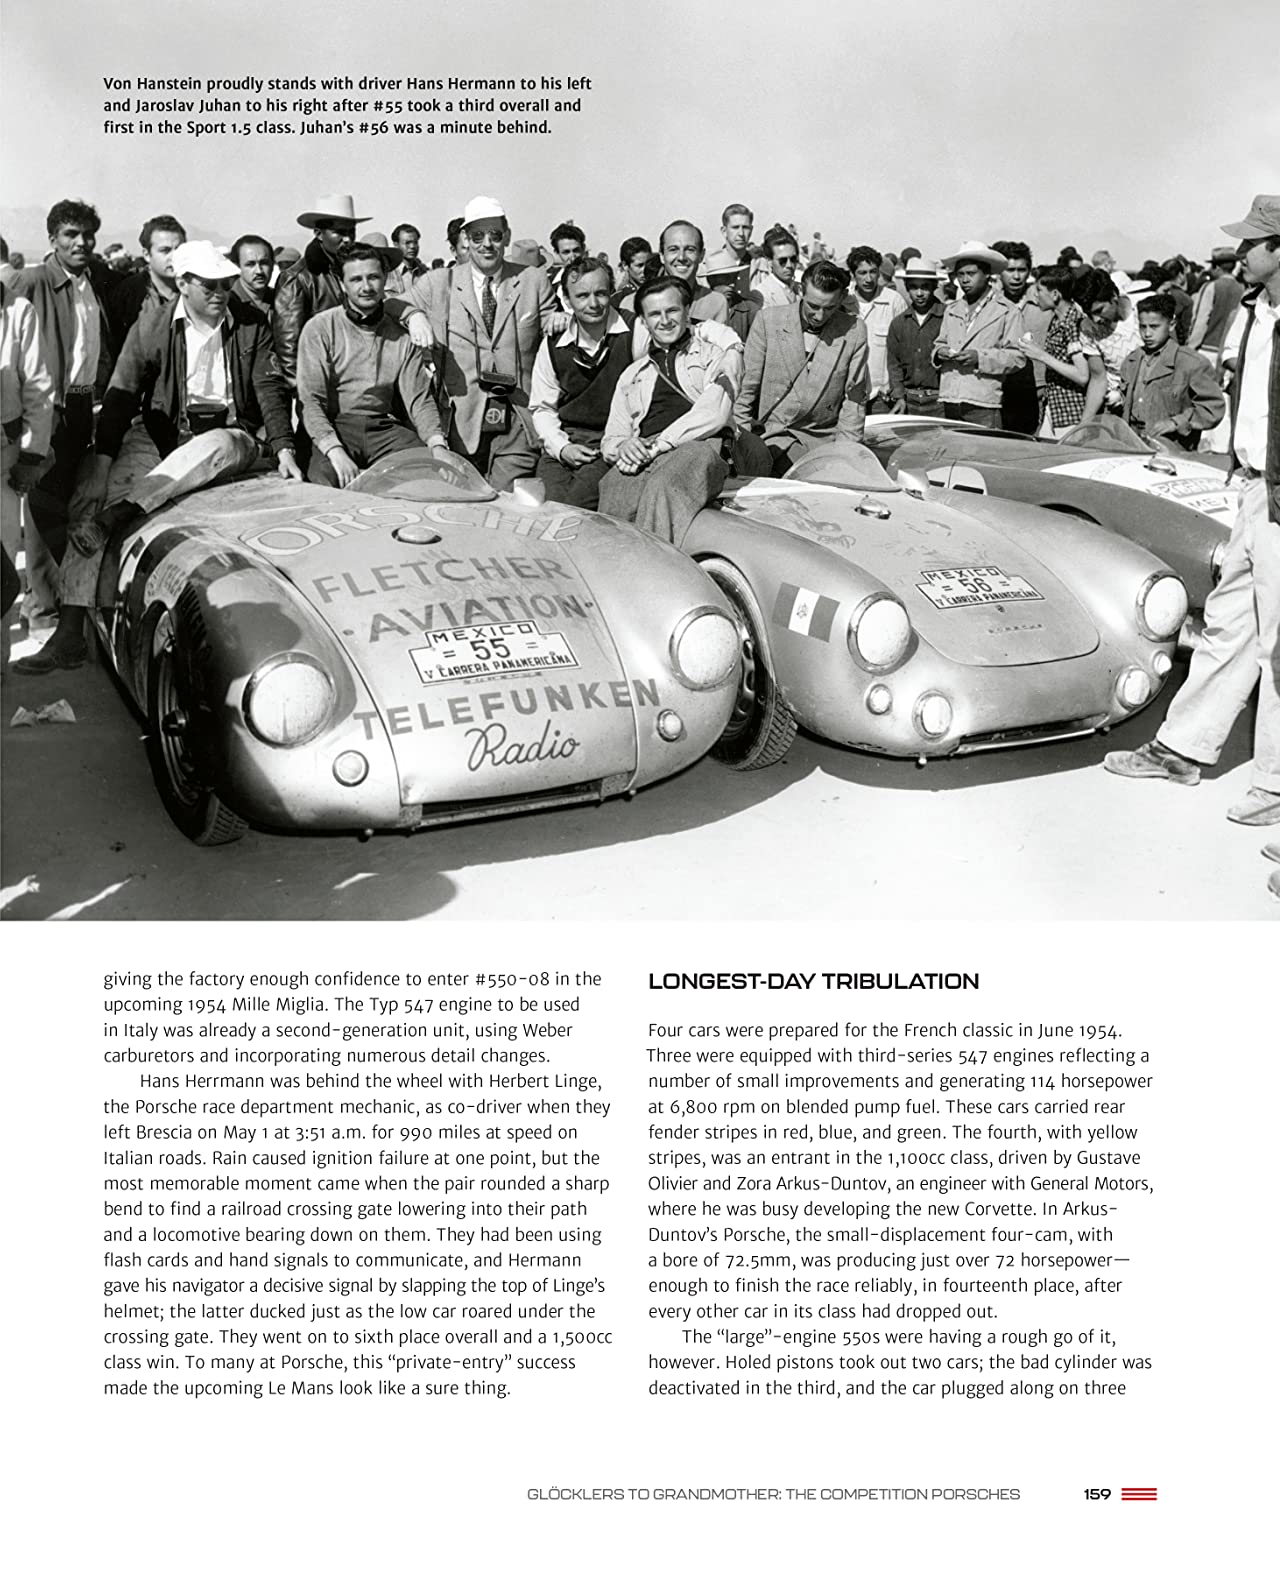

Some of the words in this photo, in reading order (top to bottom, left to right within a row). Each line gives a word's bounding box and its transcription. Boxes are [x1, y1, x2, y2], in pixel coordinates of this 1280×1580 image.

[102, 77, 132, 91] Von
[137, 76, 202, 91] Hanstein
[206, 75, 264, 94] proudly
[267, 75, 317, 91] stands
[320, 75, 354, 91] with
[358, 75, 403, 91] driver
[406, 77, 444, 91] Hans
[448, 77, 516, 91] Hermann
[519, 78, 537, 91] to
[540, 75, 563, 91] his
[567, 76, 593, 91] left
[103, 97, 131, 112] and
[134, 98, 195, 114] Jaroslav
[198, 97, 241, 114] Juhan
[245, 99, 262, 112] to
[266, 97, 288, 112] his
[292, 97, 328, 116] right
[332, 98, 369, 112] after
[373, 100, 403, 114] #55
[406, 98, 442, 113] took
[444, 101, 454, 113] a
[457, 97, 495, 113] third
[499, 98, 550, 113] overall
[554, 97, 582, 113] and
[103, 119, 135, 134] first
[138, 120, 153, 134] in
[157, 119, 183, 134] the
[186, 120, 227, 138] Sport
[230, 122, 252, 136] 1.5
[255, 120, 296, 134] class.
[299, 119, 355, 136] Juhan’s
[358, 120, 389, 136] #56
[393, 123, 423, 134] was
[426, 123, 435, 134] a
[440, 120, 493, 134] minute
[497, 119, 552, 134] behind.
[312, 556, 574, 603] FLETCHER
[927, 567, 1000, 581] MEXICO
[958, 577, 993, 594] 56
[431, 622, 534, 644] MEXICO
[470, 637, 511, 661] 55
[439, 661, 490, 678] CARRERA
[492, 654, 573, 671] PANAMERICANA
[353, 678, 662, 741] TELEFUNKEN
[464, 718, 581, 772] Radio
[648, 972, 817, 990] LONGEST-DAY
[821, 972, 980, 990] TRIBULATION
[140, 1073, 180, 1089] Hans
[185, 1073, 265, 1089] Herrmann
[269, 1076, 301, 1089] was
[306, 1072, 360, 1089] behind
[364, 1072, 392, 1089] the
[396, 1072, 443, 1089] wheel
[447, 1072, 483, 1089] with
[489, 1072, 550, 1089] Herbert
[555, 1072, 602, 1093] Linge,
[648, 1072, 711, 1089] number
[715, 1072, 733, 1089] of
[737, 1072, 779, 1089] small
[784, 1072, 900, 1093] improvements
[904, 1072, 934, 1089] and
[939, 1072, 1026, 1093] generating
[1030, 1075, 1056, 1091] 114
[1061, 1072, 1154, 1093] horsepower
[527, 1485, 625, 1501] GLÖCKLERS
[627, 1488, 650, 1501] TO
[652, 1488, 782, 1501] GRANDMOTHER:
[784, 1488, 817, 1501] THE
[820, 1488, 928, 1501] COMPETITION
[931, 1488, 1021, 1501] PORSCHES
[1083, 1488, 1112, 1501] 159
